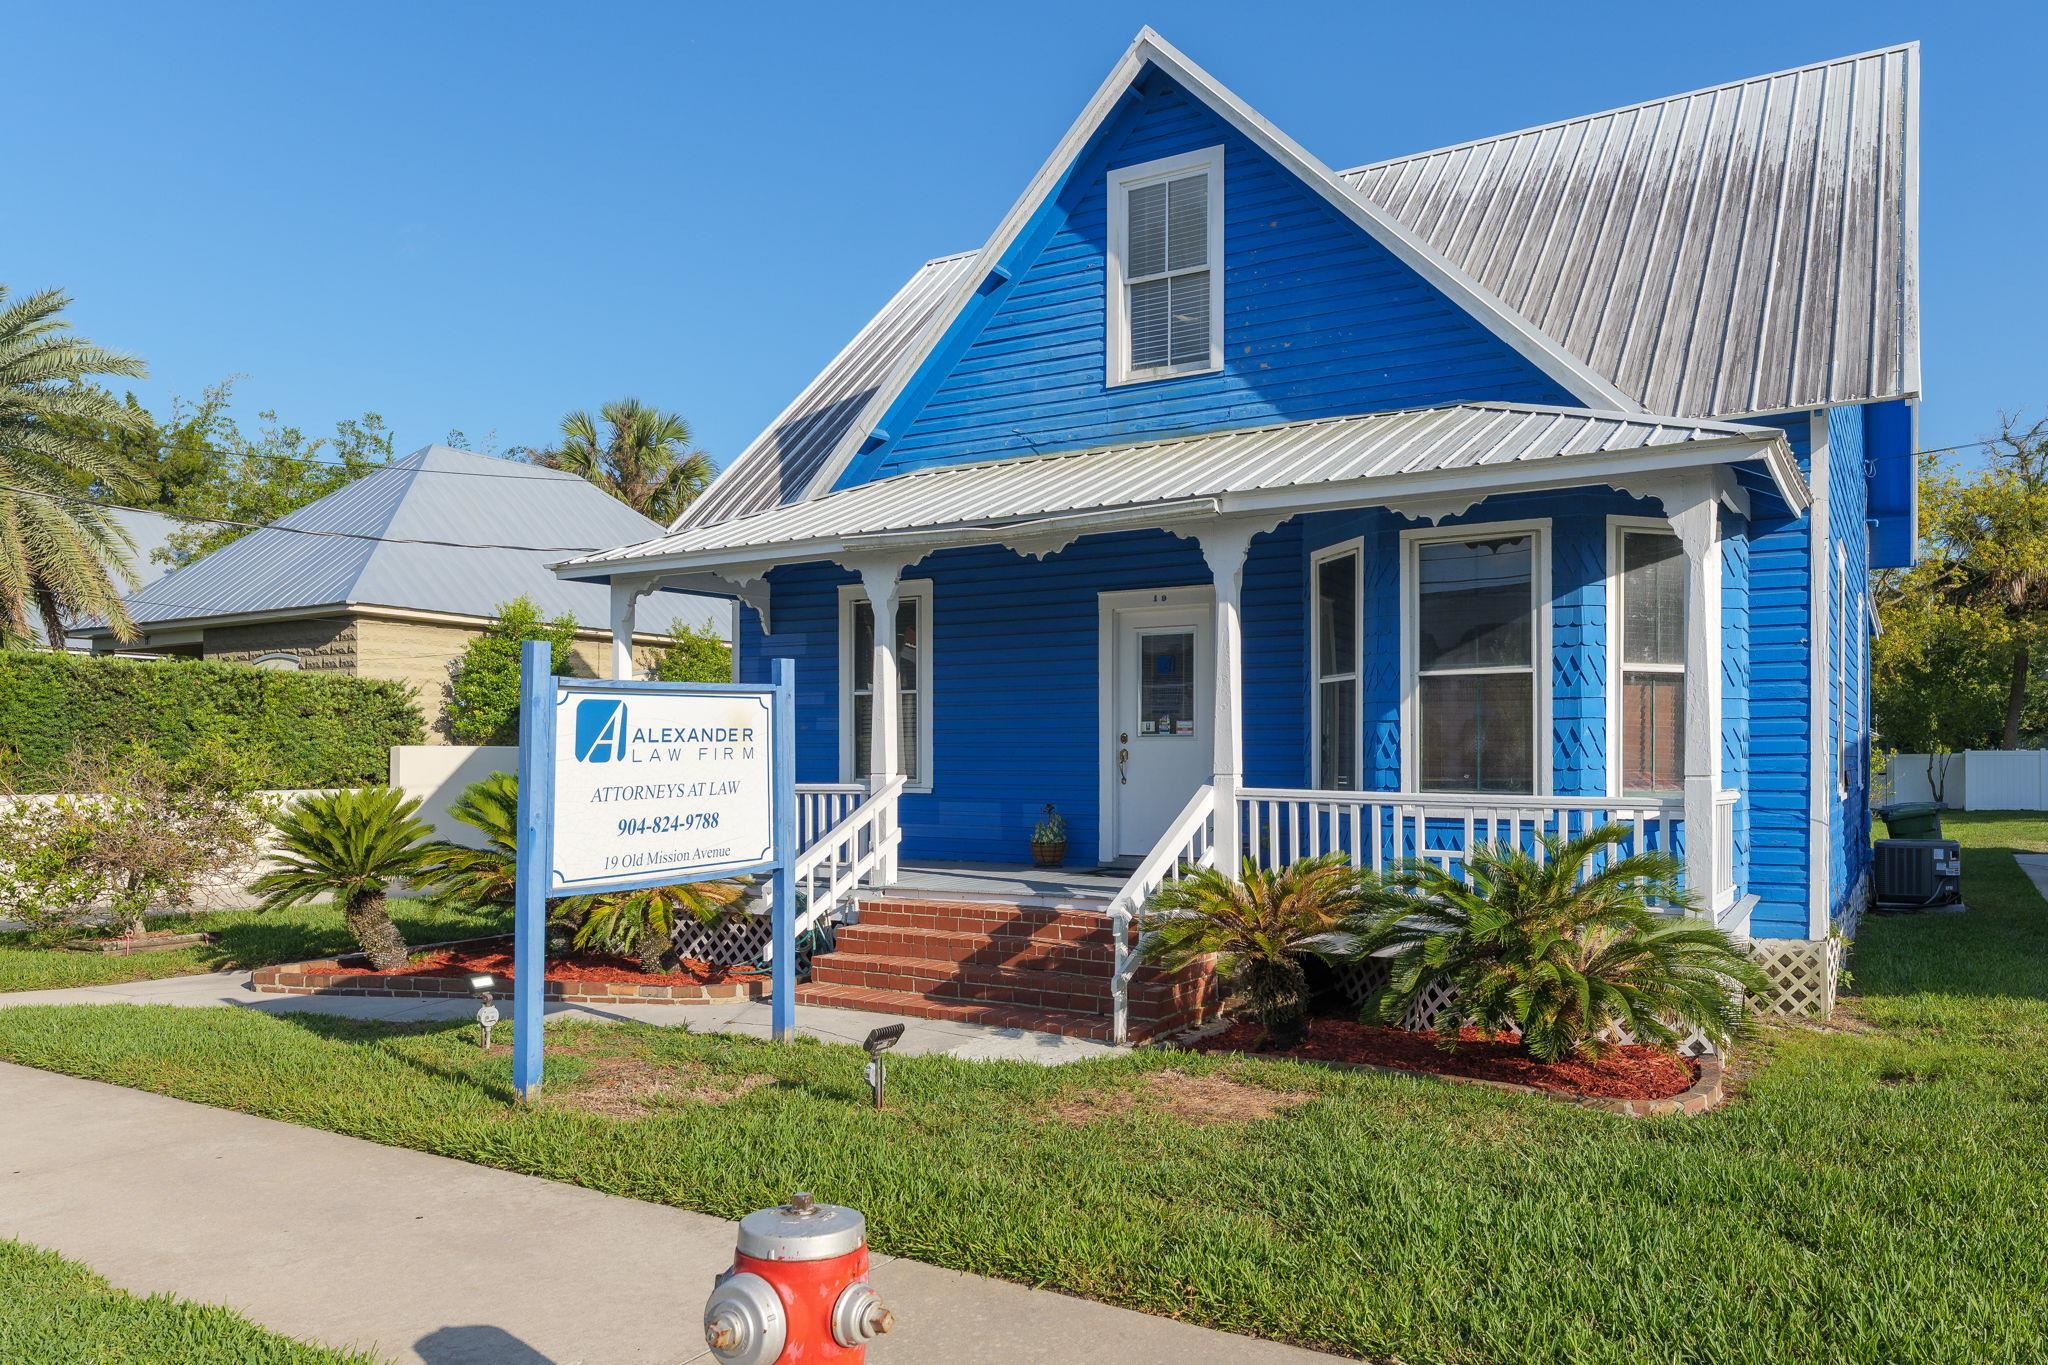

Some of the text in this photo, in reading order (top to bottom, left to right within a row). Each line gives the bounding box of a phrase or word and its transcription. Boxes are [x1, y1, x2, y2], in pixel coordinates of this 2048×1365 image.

[632, 728, 754, 744] ALEXANDER
[632, 746, 754, 763] LAW FIRM
[590, 780, 741, 803] ATTORNEYS AT LAW
[617, 812, 720, 837] 904-824-9788
[605, 846, 732, 870] 19 Old Mission Avenue
